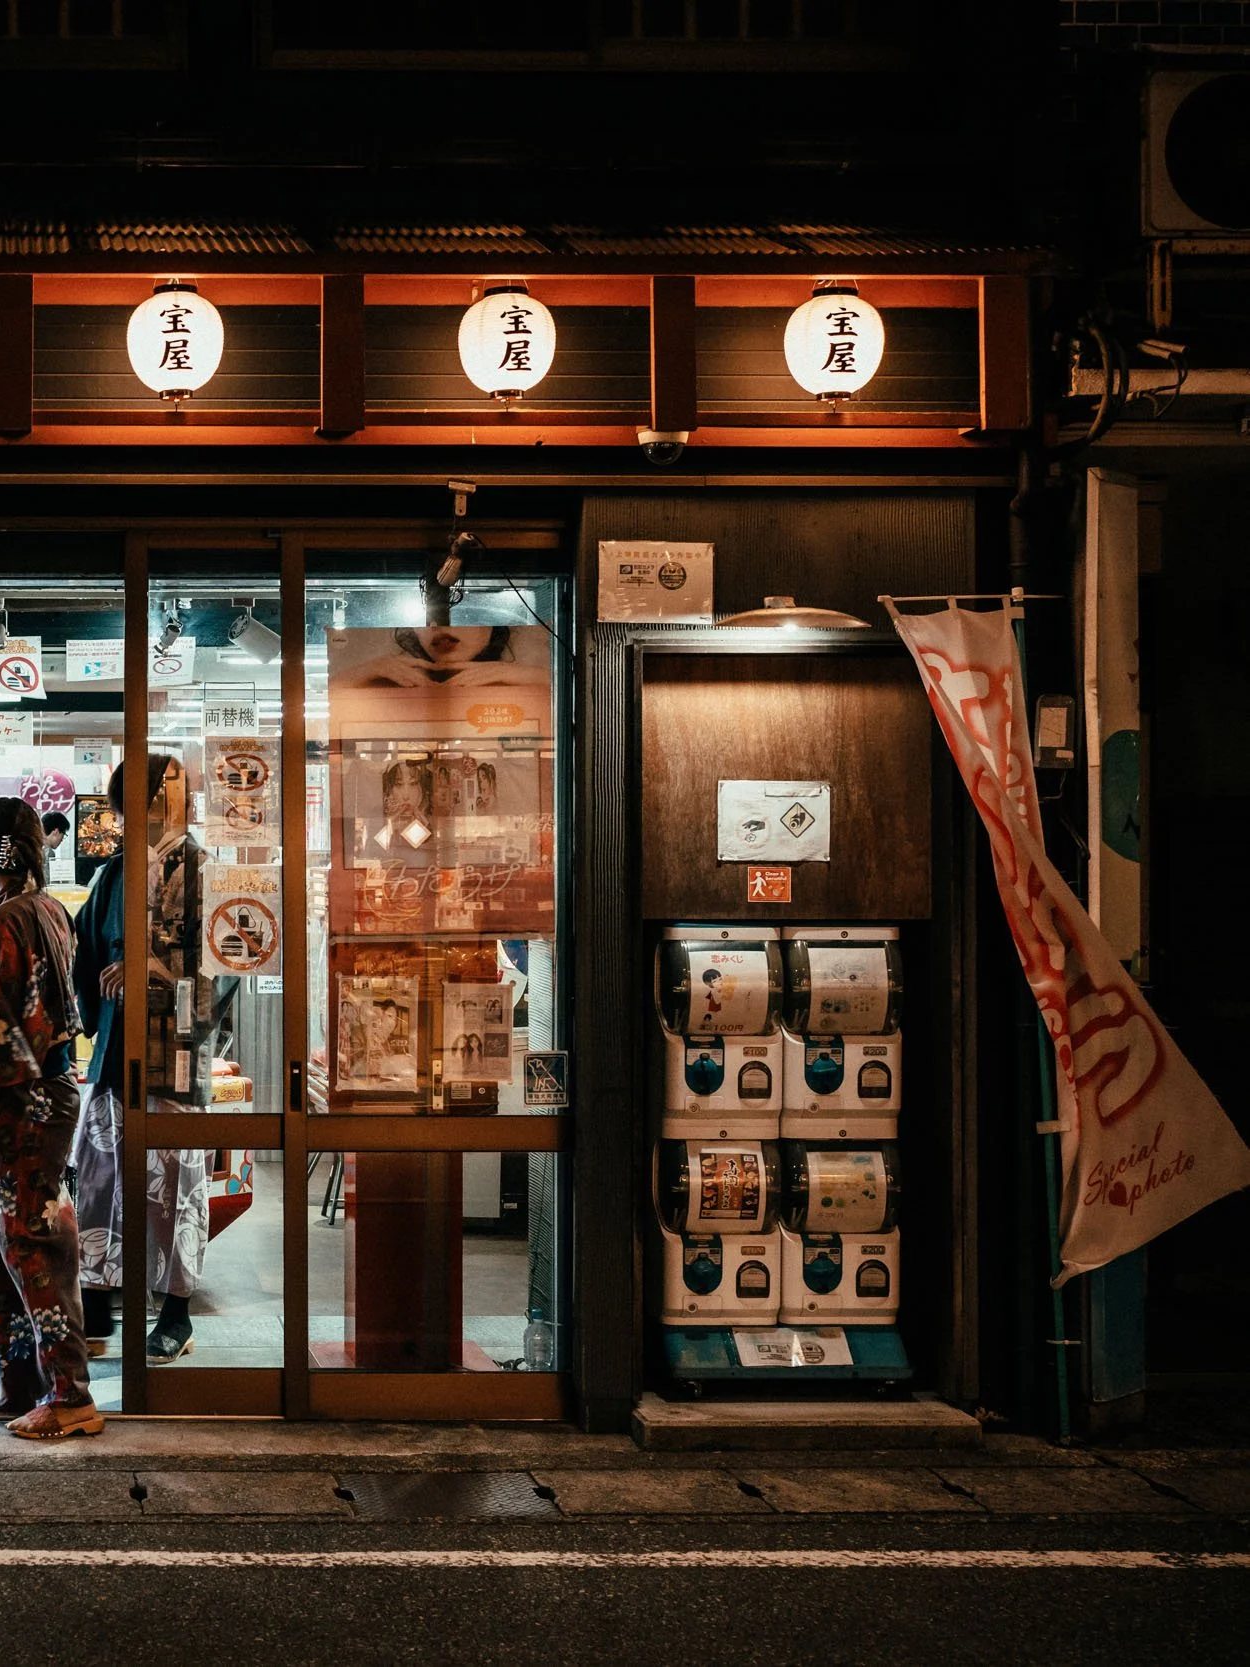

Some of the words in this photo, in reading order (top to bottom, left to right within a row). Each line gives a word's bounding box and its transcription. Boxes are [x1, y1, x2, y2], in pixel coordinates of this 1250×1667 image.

[158, 303, 194, 371] 宝屋
[498, 304, 534, 372] 宝屋
[822, 305, 860, 374] 宝屋
[205, 708, 255, 728] 両替機
[711, 954, 744, 964] 恋みくじ
[1084, 1121, 1165, 1206] Special
[1129, 1150, 1195, 1216] photo
